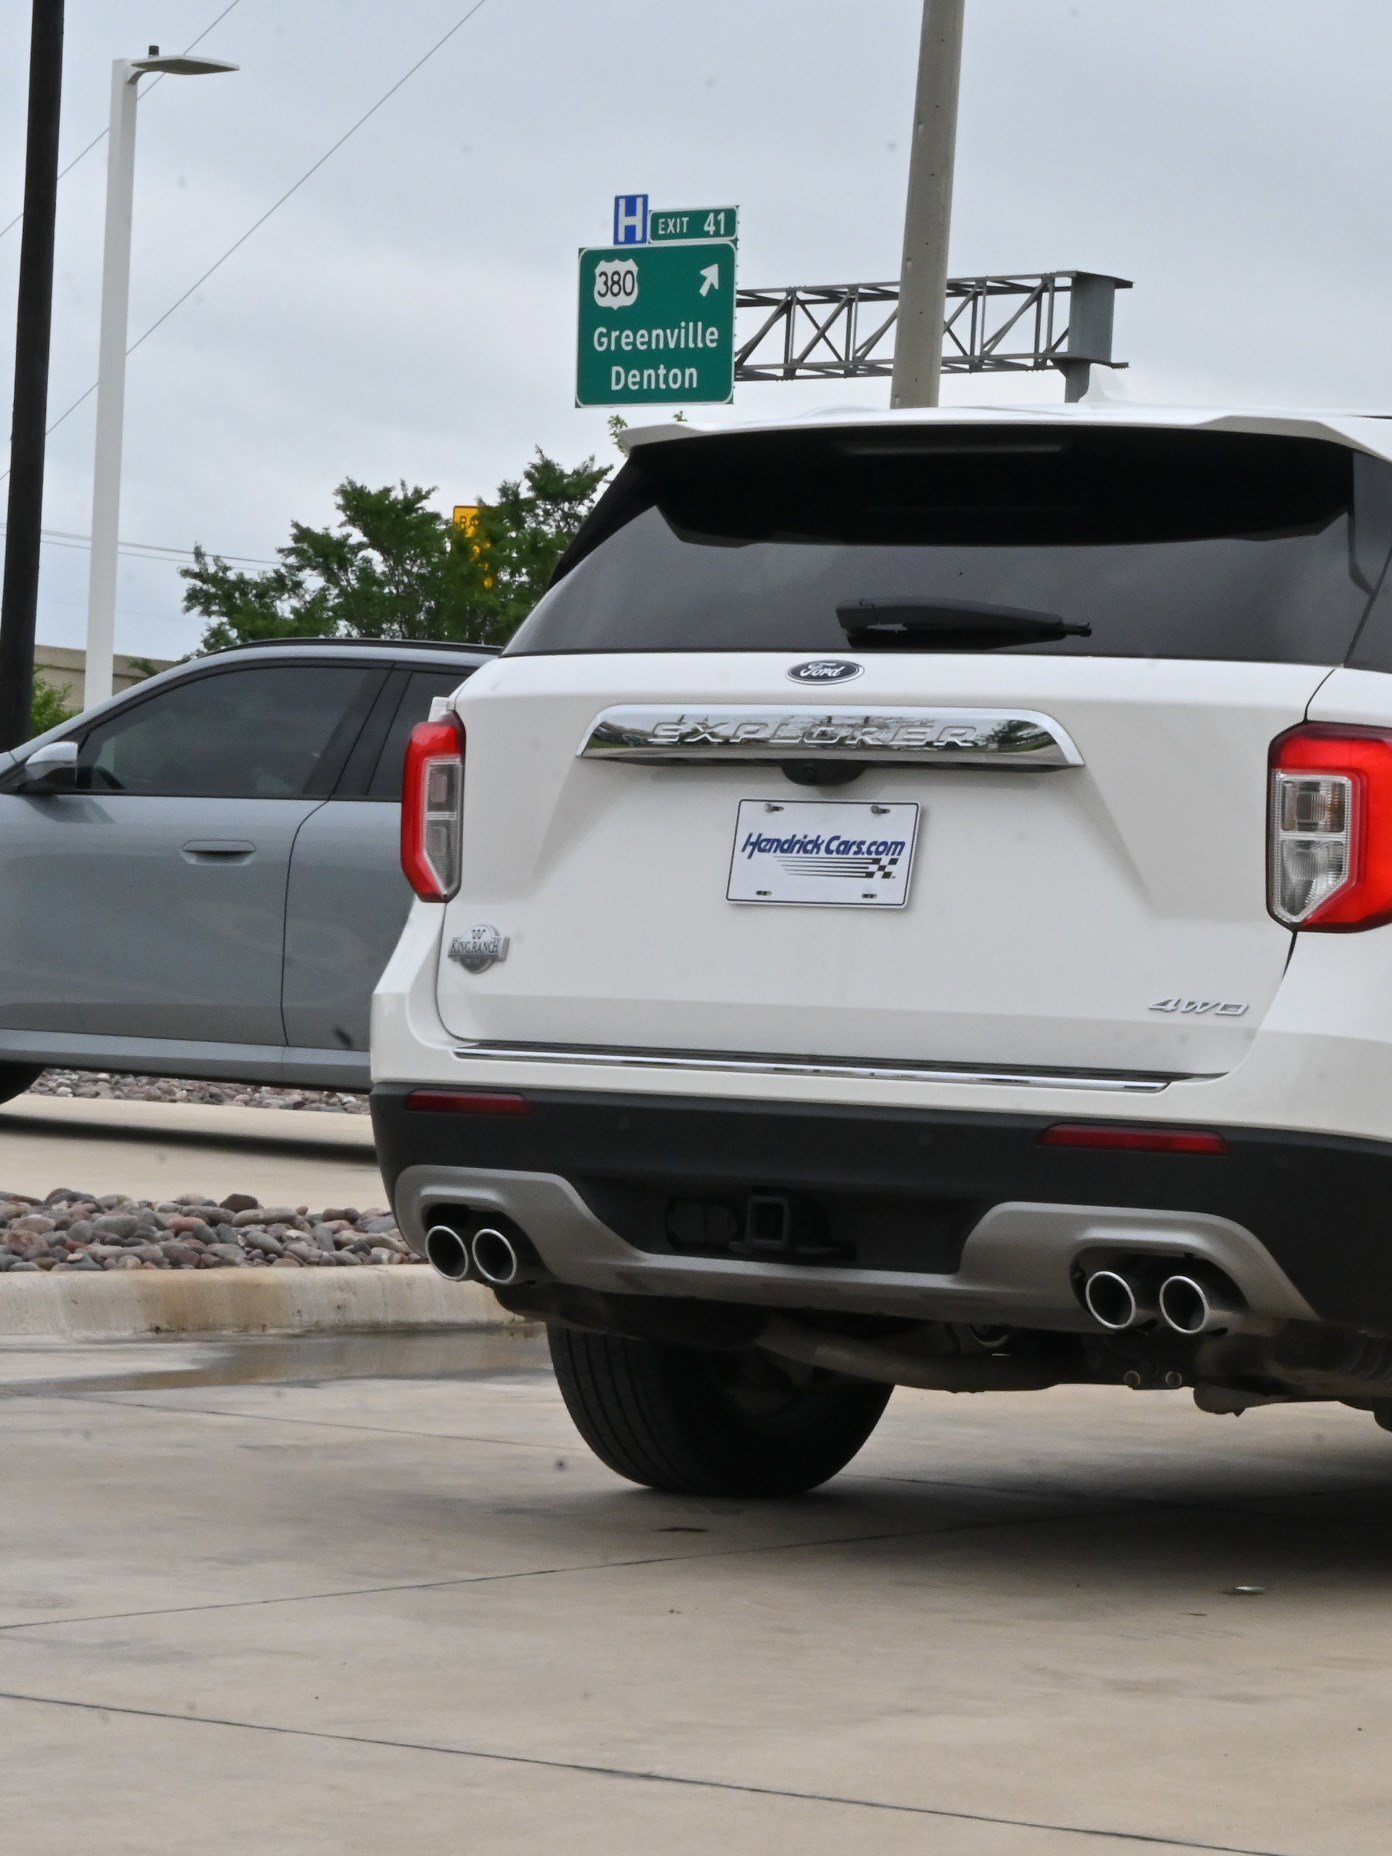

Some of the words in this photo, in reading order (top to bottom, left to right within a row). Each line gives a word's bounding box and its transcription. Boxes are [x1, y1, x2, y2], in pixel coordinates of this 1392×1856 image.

[617, 197, 643, 242] H
[658, 217, 690, 235] EXIT
[703, 212, 726, 235] 41
[597, 270, 635, 298] 380
[593, 321, 719, 351] Greenville
[611, 364, 698, 391] Denton
[800, 662, 845, 677] Ford
[648, 721, 977, 747] EXPLORER
[449, 940, 471, 955] KING
[472, 940, 498, 955] RANCH
[1148, 998, 1249, 1017] 4WD
